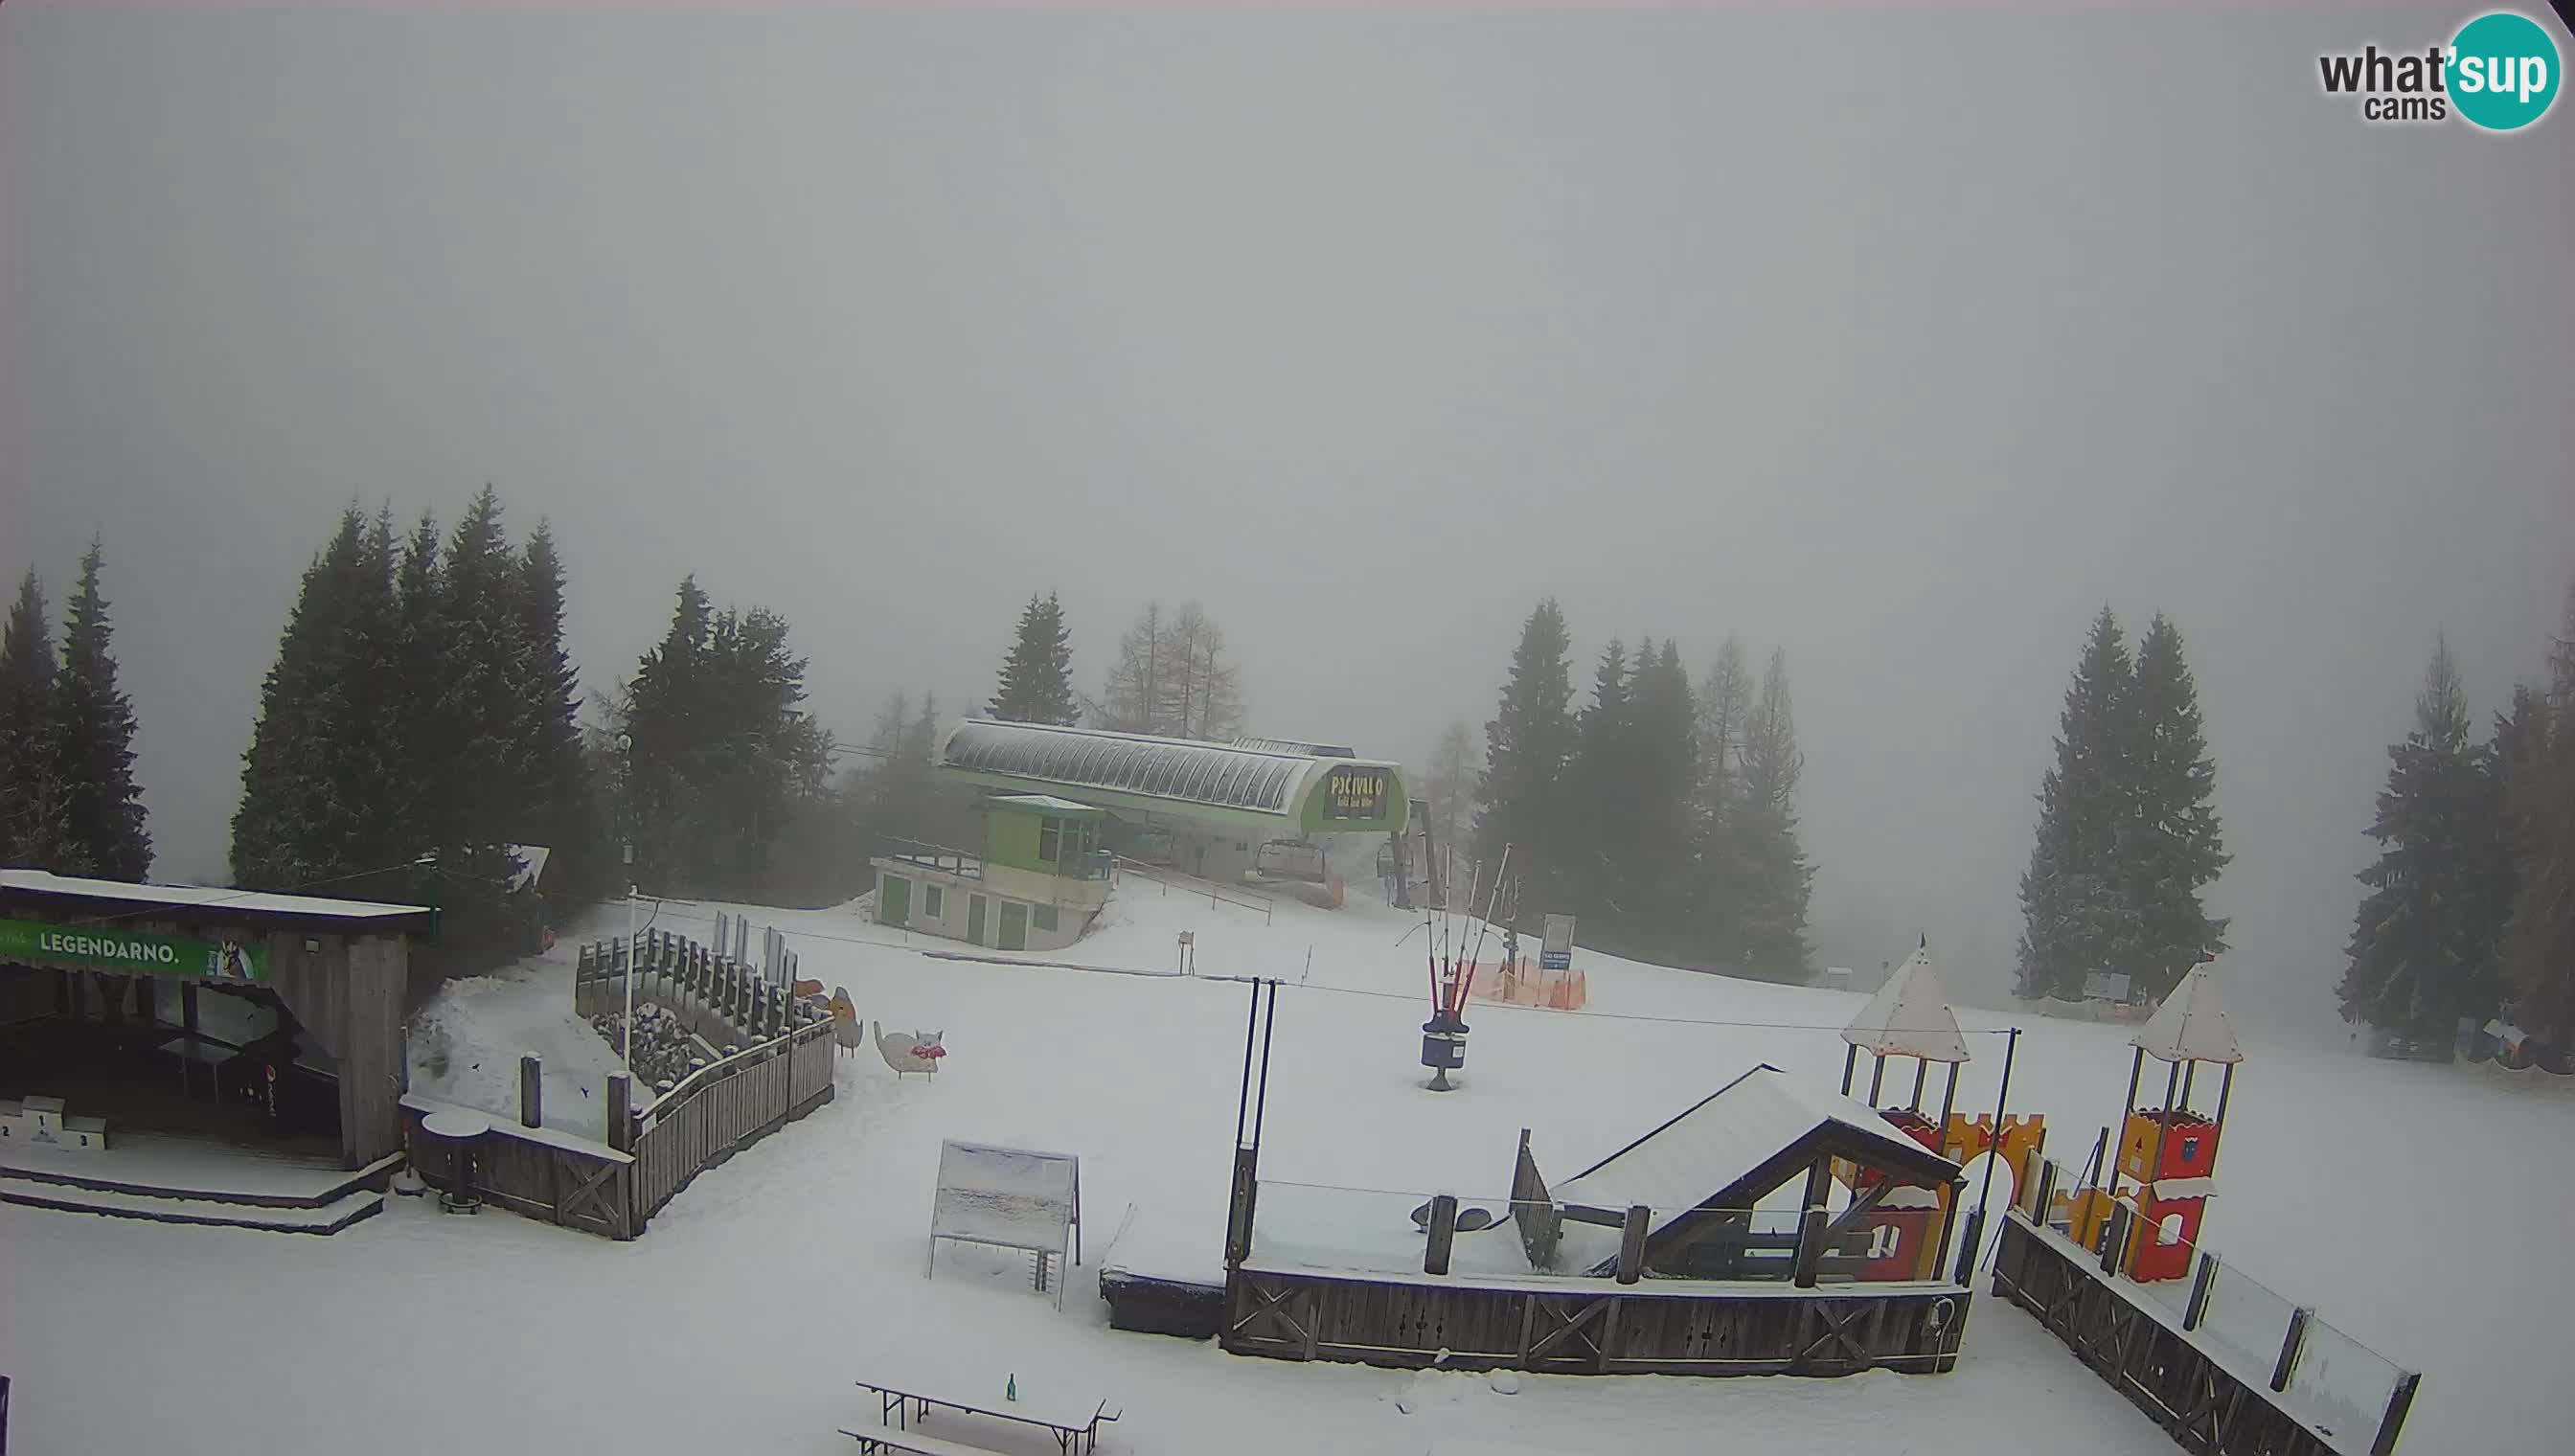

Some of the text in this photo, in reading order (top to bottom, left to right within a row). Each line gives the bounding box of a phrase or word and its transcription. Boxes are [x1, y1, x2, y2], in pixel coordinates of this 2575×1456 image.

[40, 932, 180, 965] LEGENDARNO.
[2, 1126, 11, 1137] 2
[80, 1134, 88, 1147] 3
